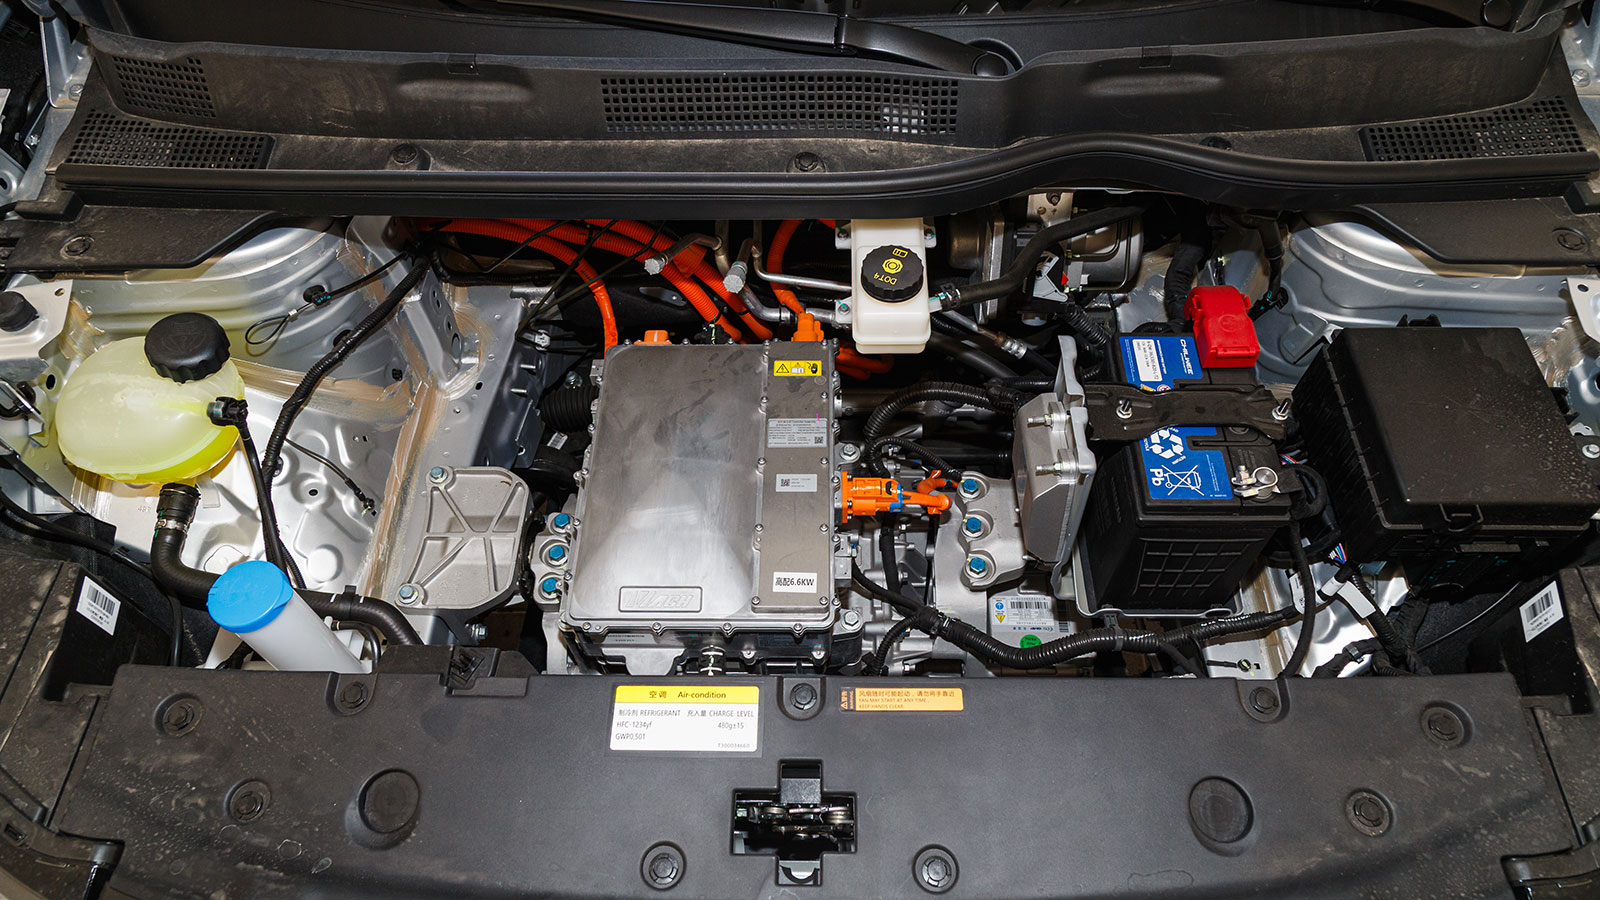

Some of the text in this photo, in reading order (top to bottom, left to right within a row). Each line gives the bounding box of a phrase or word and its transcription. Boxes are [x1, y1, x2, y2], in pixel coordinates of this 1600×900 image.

[1179, 338, 1194, 375] CHILWEE
[1149, 468, 1165, 486] Pb
[677, 691, 727, 699] Air-condition
[639, 709, 681, 717] REFRIGERANT
[616, 720, 652, 729] HFC-1234yf
